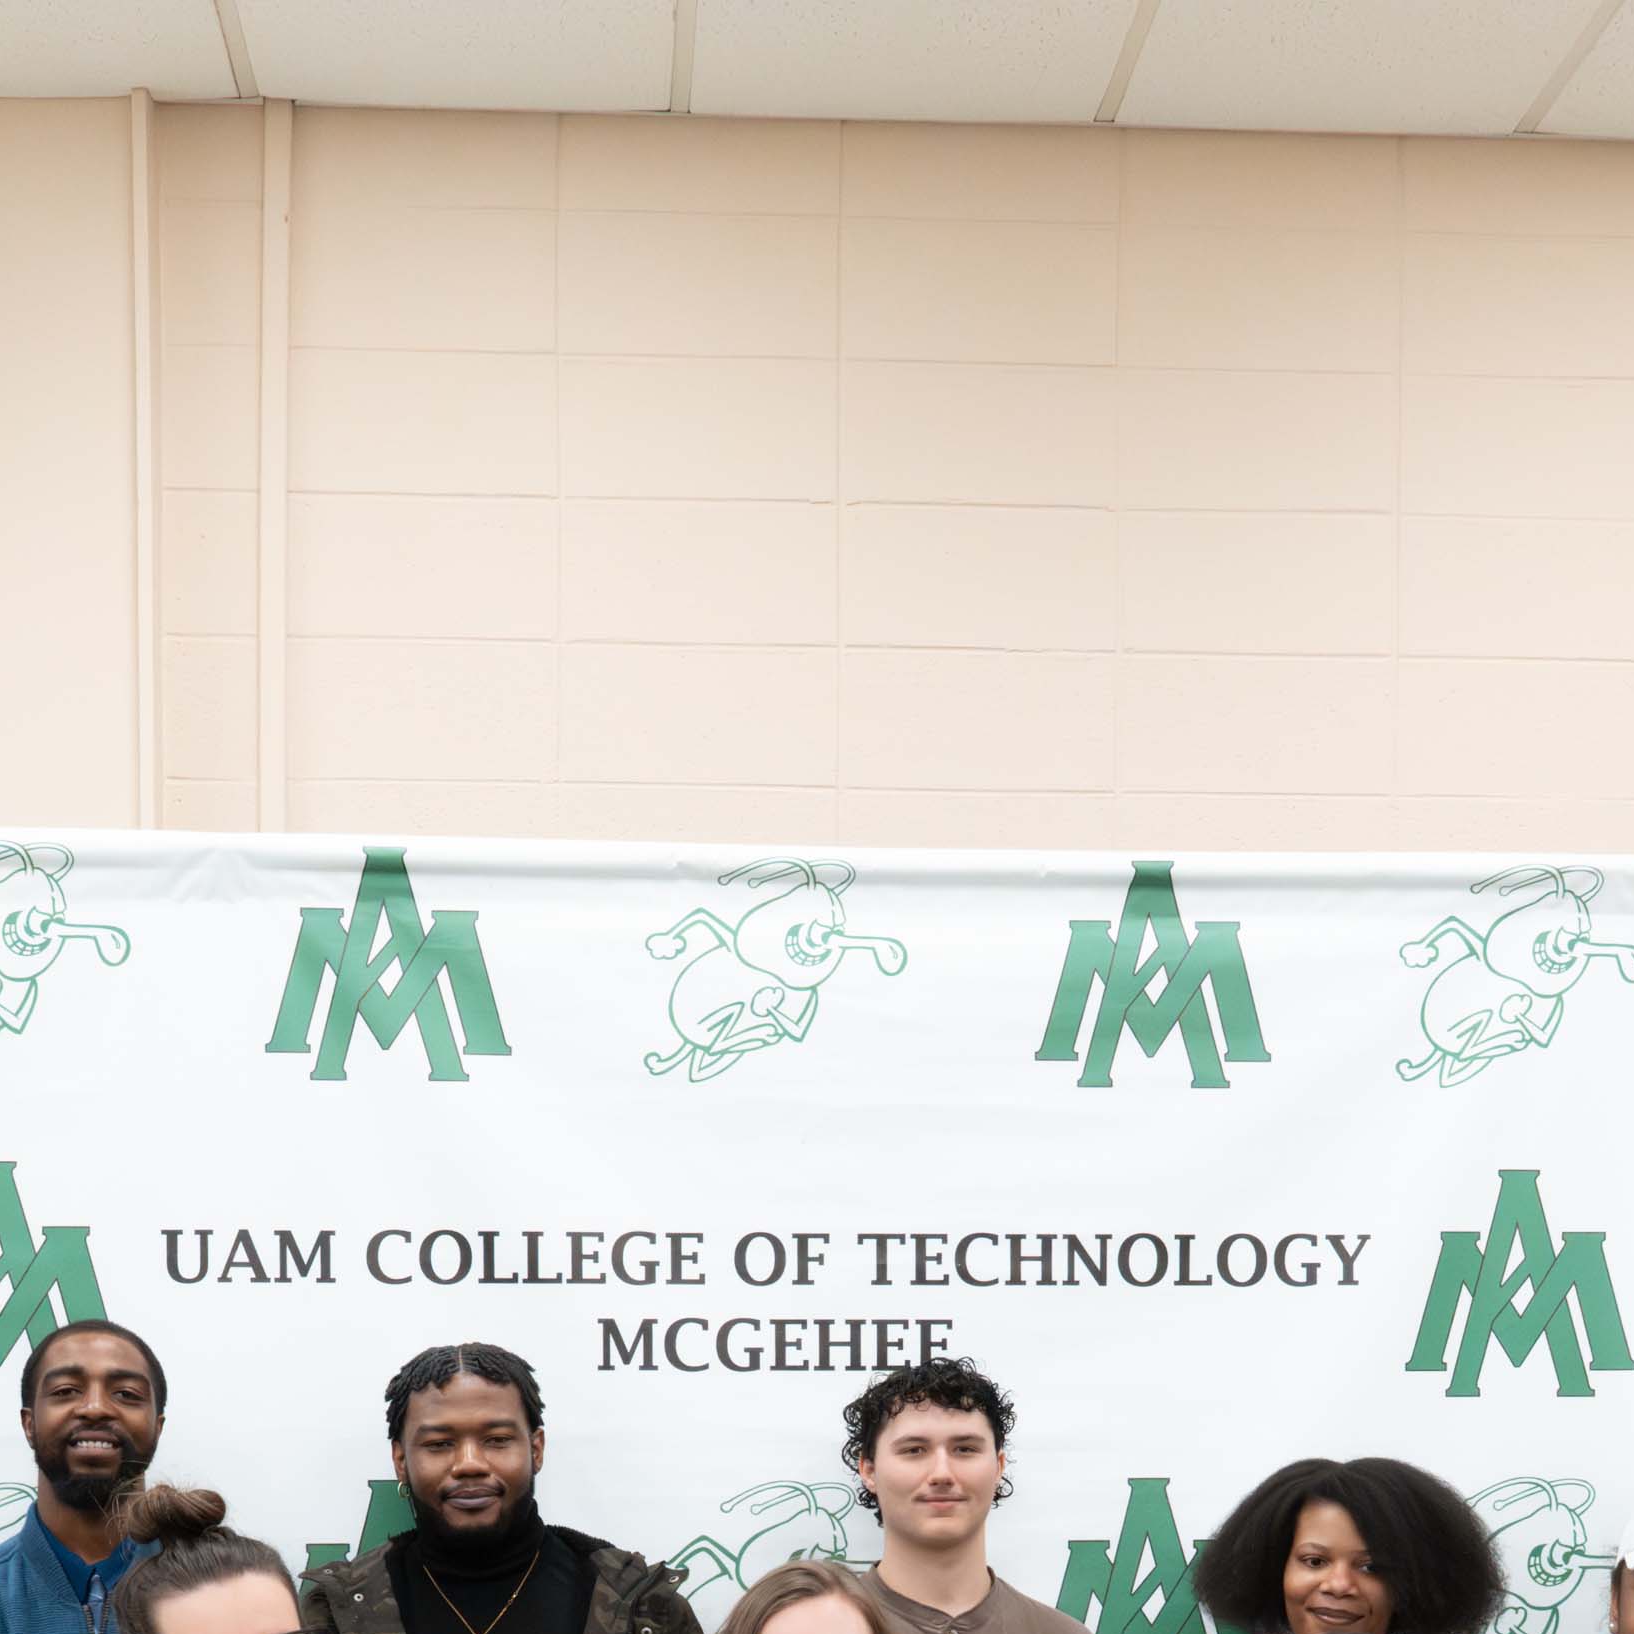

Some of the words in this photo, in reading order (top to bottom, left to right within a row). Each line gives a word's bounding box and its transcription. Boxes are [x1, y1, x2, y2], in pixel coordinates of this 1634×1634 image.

[160, 1228, 337, 1285] UAM
[365, 1229, 707, 1286] COLLEGE
[733, 1231, 830, 1287] OF
[856, 1232, 1372, 1288] TECHNOLOGY
